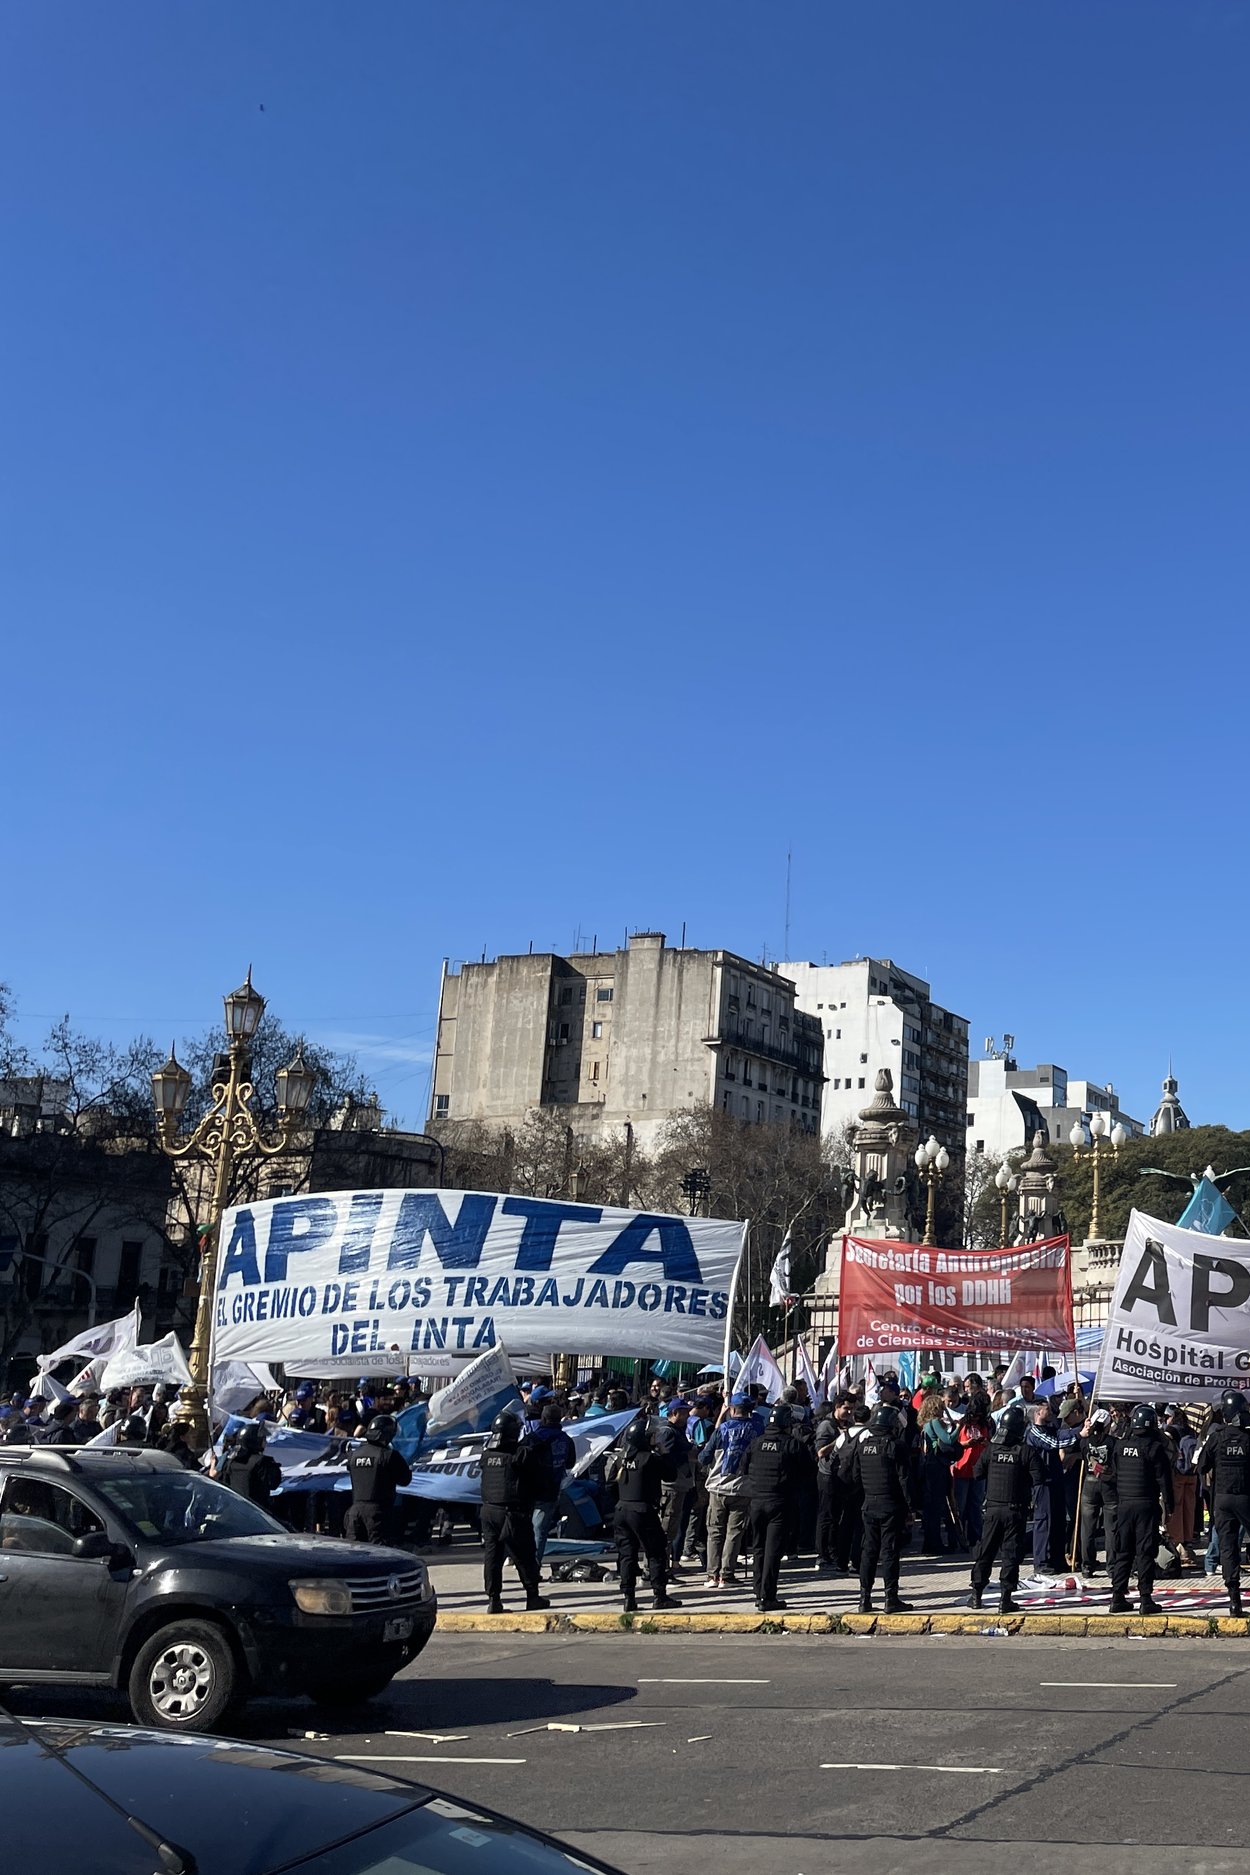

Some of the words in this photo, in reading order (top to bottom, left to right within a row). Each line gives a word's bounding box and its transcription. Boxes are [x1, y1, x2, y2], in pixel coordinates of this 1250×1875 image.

[218, 1192, 703, 1291] APINTA
[845, 1239, 930, 1273] Secretaría
[217, 1296, 228, 1328] EL
[232, 1285, 317, 1324] GREMIO
[321, 1281, 360, 1315] DE
[368, 1276, 432, 1311] LOS
[443, 1275, 729, 1320] TRABAJADORES
[894, 1283, 923, 1307] por
[928, 1280, 957, 1307] los
[961, 1279, 1012, 1306] DDHH
[331, 1319, 386, 1356] DEL
[411, 1316, 496, 1351] INTA
[870, 1320, 921, 1334] Centro
[925, 1324, 945, 1336] de
[948, 1325, 1038, 1339] Estudiantes
[856, 1334, 874, 1348] de
[877, 1333, 943, 1347] Ciencias
[946, 1337, 1008, 1347] Sociales
[1116, 1327, 1224, 1371] Hospital
[1114, 1359, 1181, 1385] Asociación
[1184, 1374, 1200, 1386] de
[762, 1442, 777, 1451] PFA
[862, 1445, 878, 1456] PFA
[1123, 1447, 1139, 1458] PFA
[1226, 1446, 1244, 1456] PFA
[356, 1457, 372, 1467] PFA
[487, 1457, 502, 1467] PFA
[998, 1452, 1014, 1463] PFA
